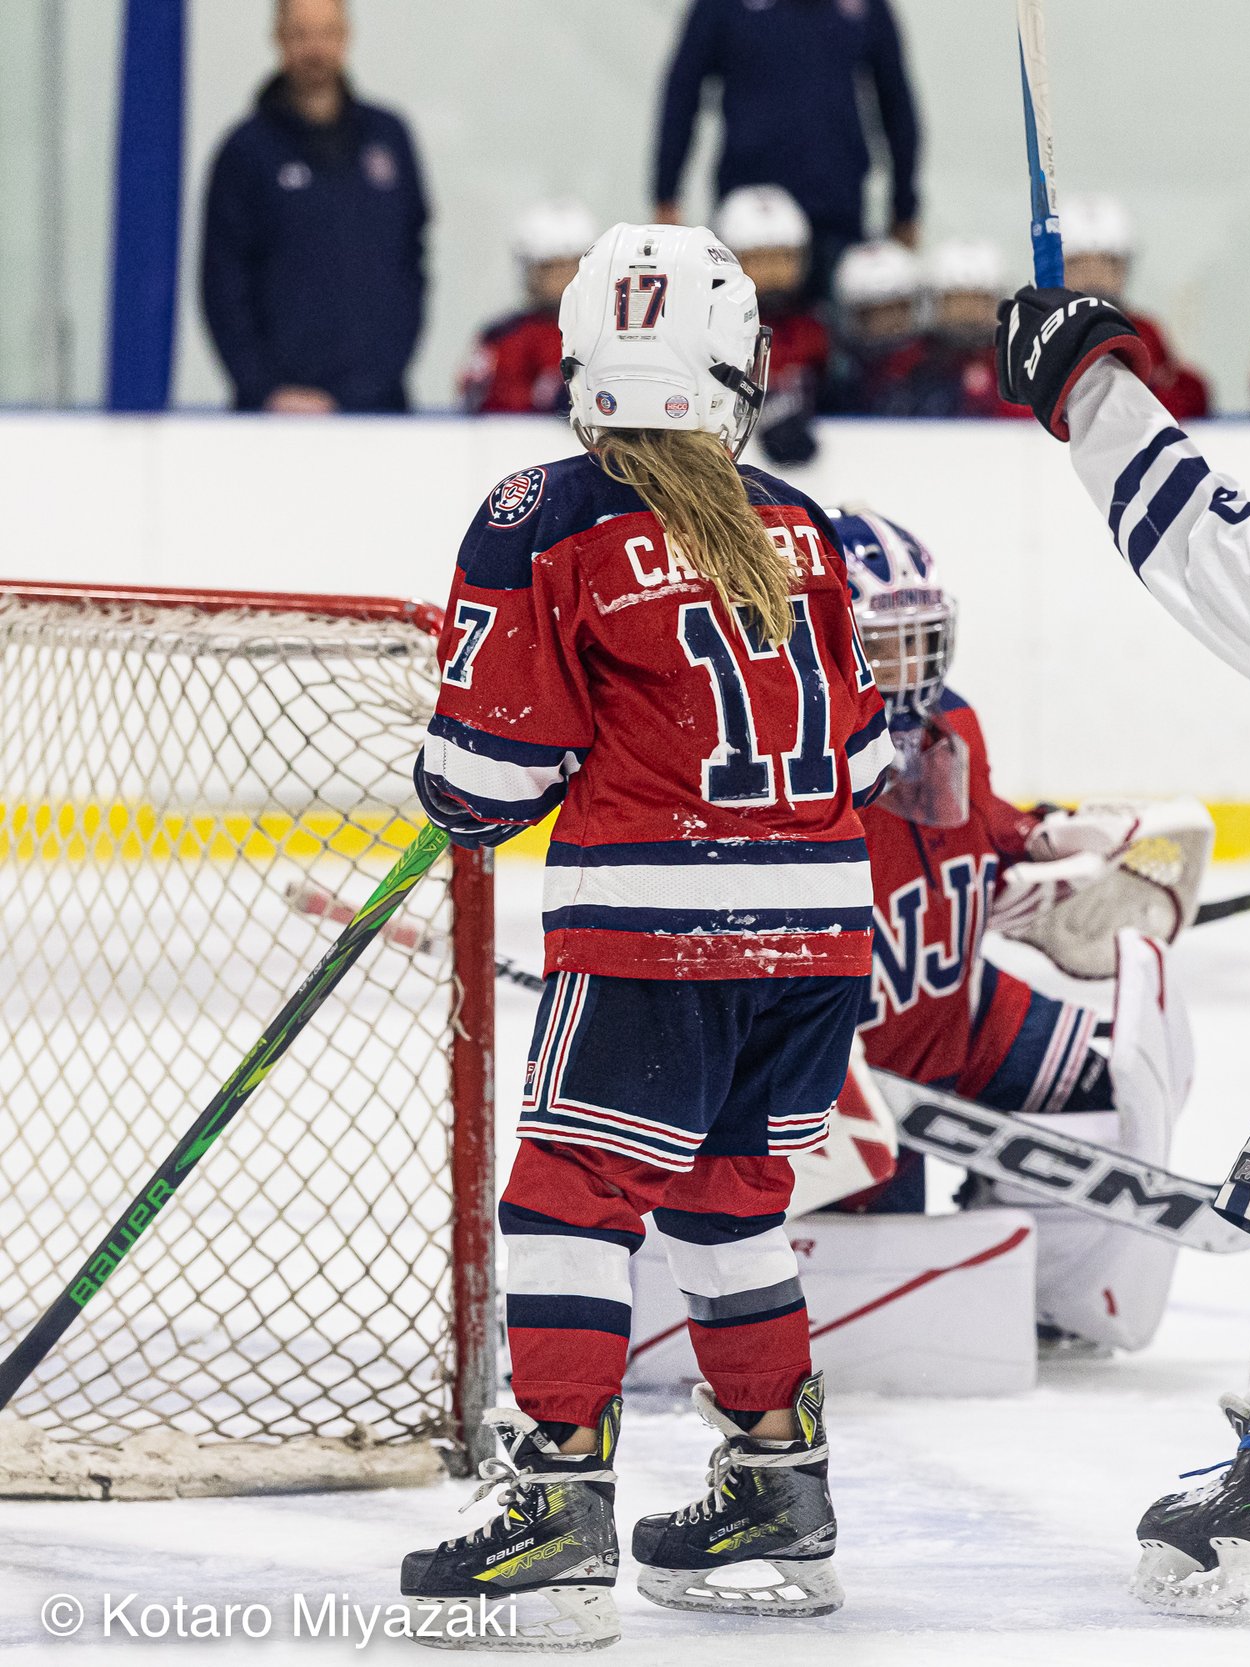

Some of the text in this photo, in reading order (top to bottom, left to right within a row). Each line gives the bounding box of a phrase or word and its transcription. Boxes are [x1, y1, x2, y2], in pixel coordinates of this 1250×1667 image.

[614, 274, 669, 331] 17
[624, 525, 827, 588] CART
[677, 594, 858, 809] 17
[901, 1103, 1205, 1232] CCM
[69, 1178, 177, 1308] BAUER
[486, 1537, 535, 1566] BAUER
